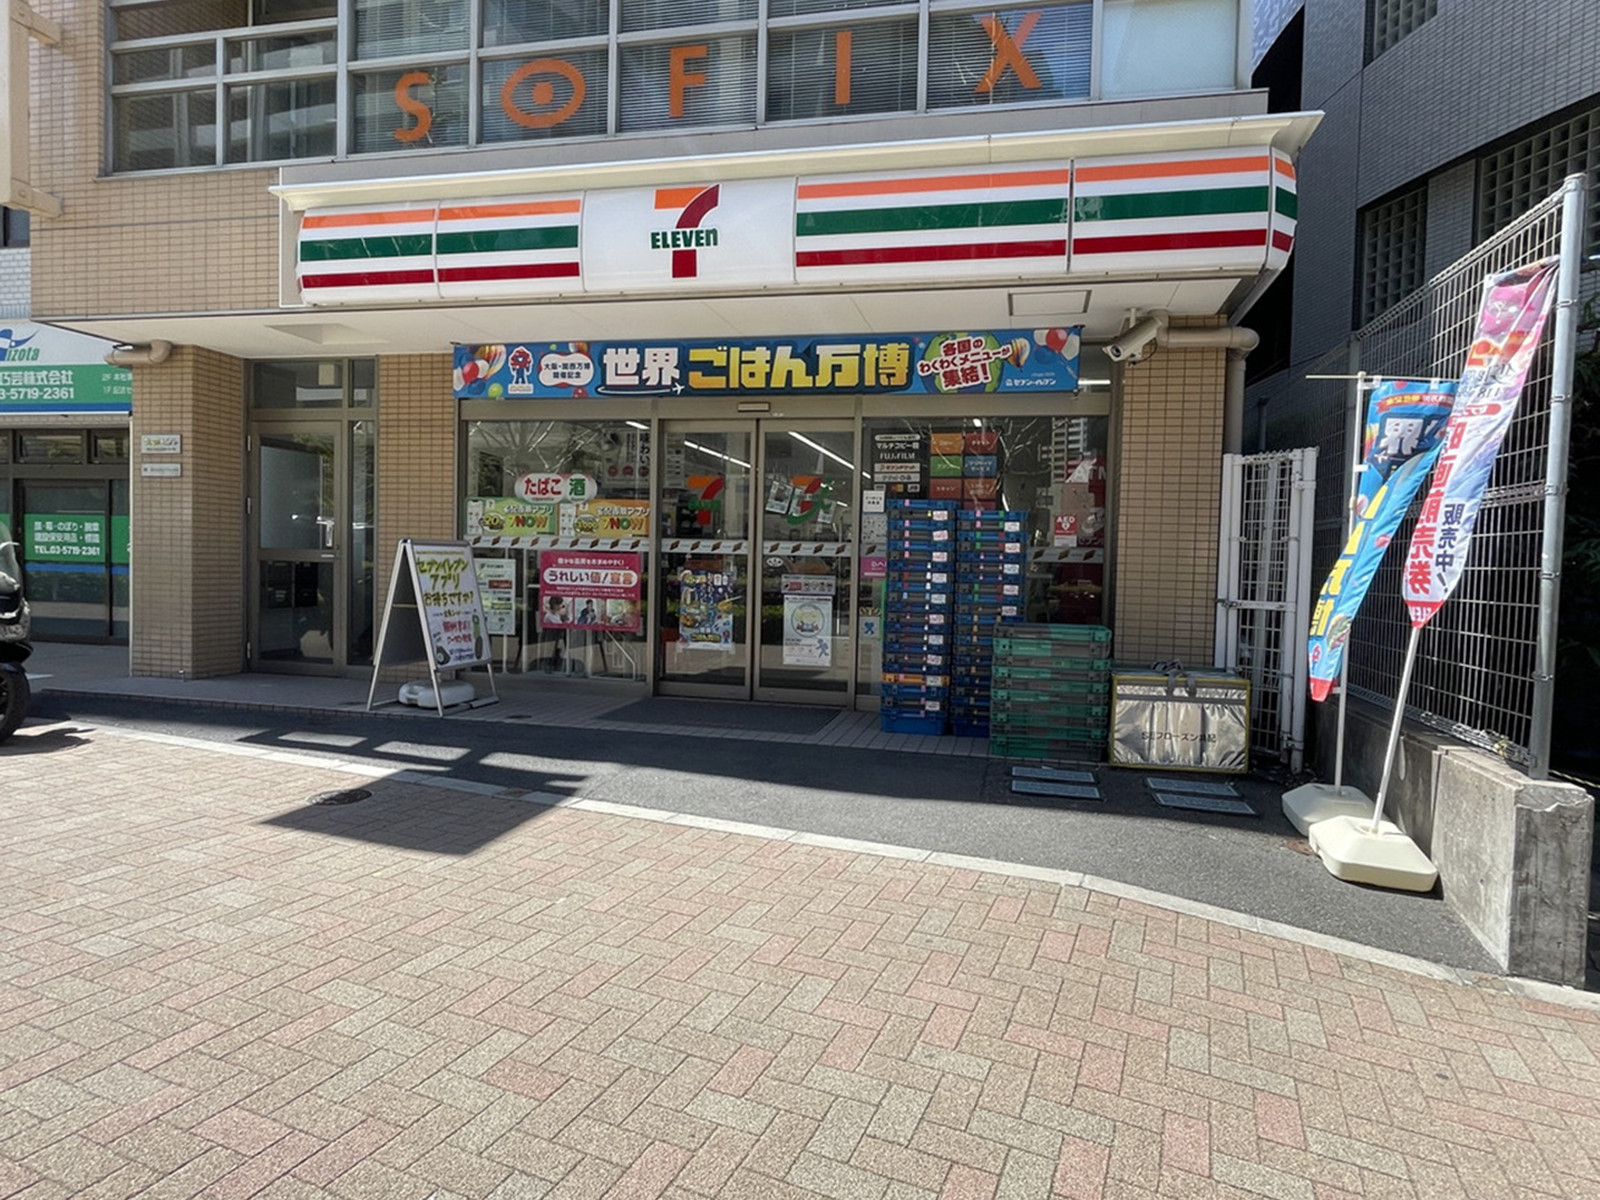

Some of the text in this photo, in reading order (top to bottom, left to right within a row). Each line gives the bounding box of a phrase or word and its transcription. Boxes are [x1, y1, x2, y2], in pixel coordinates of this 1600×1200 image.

[394, 12, 1043, 142] SOFIX
[654, 183, 720, 278] 7
[942, 338, 984, 357] 各国の
[603, 343, 910, 389] 世界ごはん万博
[919, 346, 1012, 374] わくわくメニューが
[524, 478, 562, 496] たばこ
[569, 478, 586, 496] 酒
[430, 573, 461, 591] アプリ
